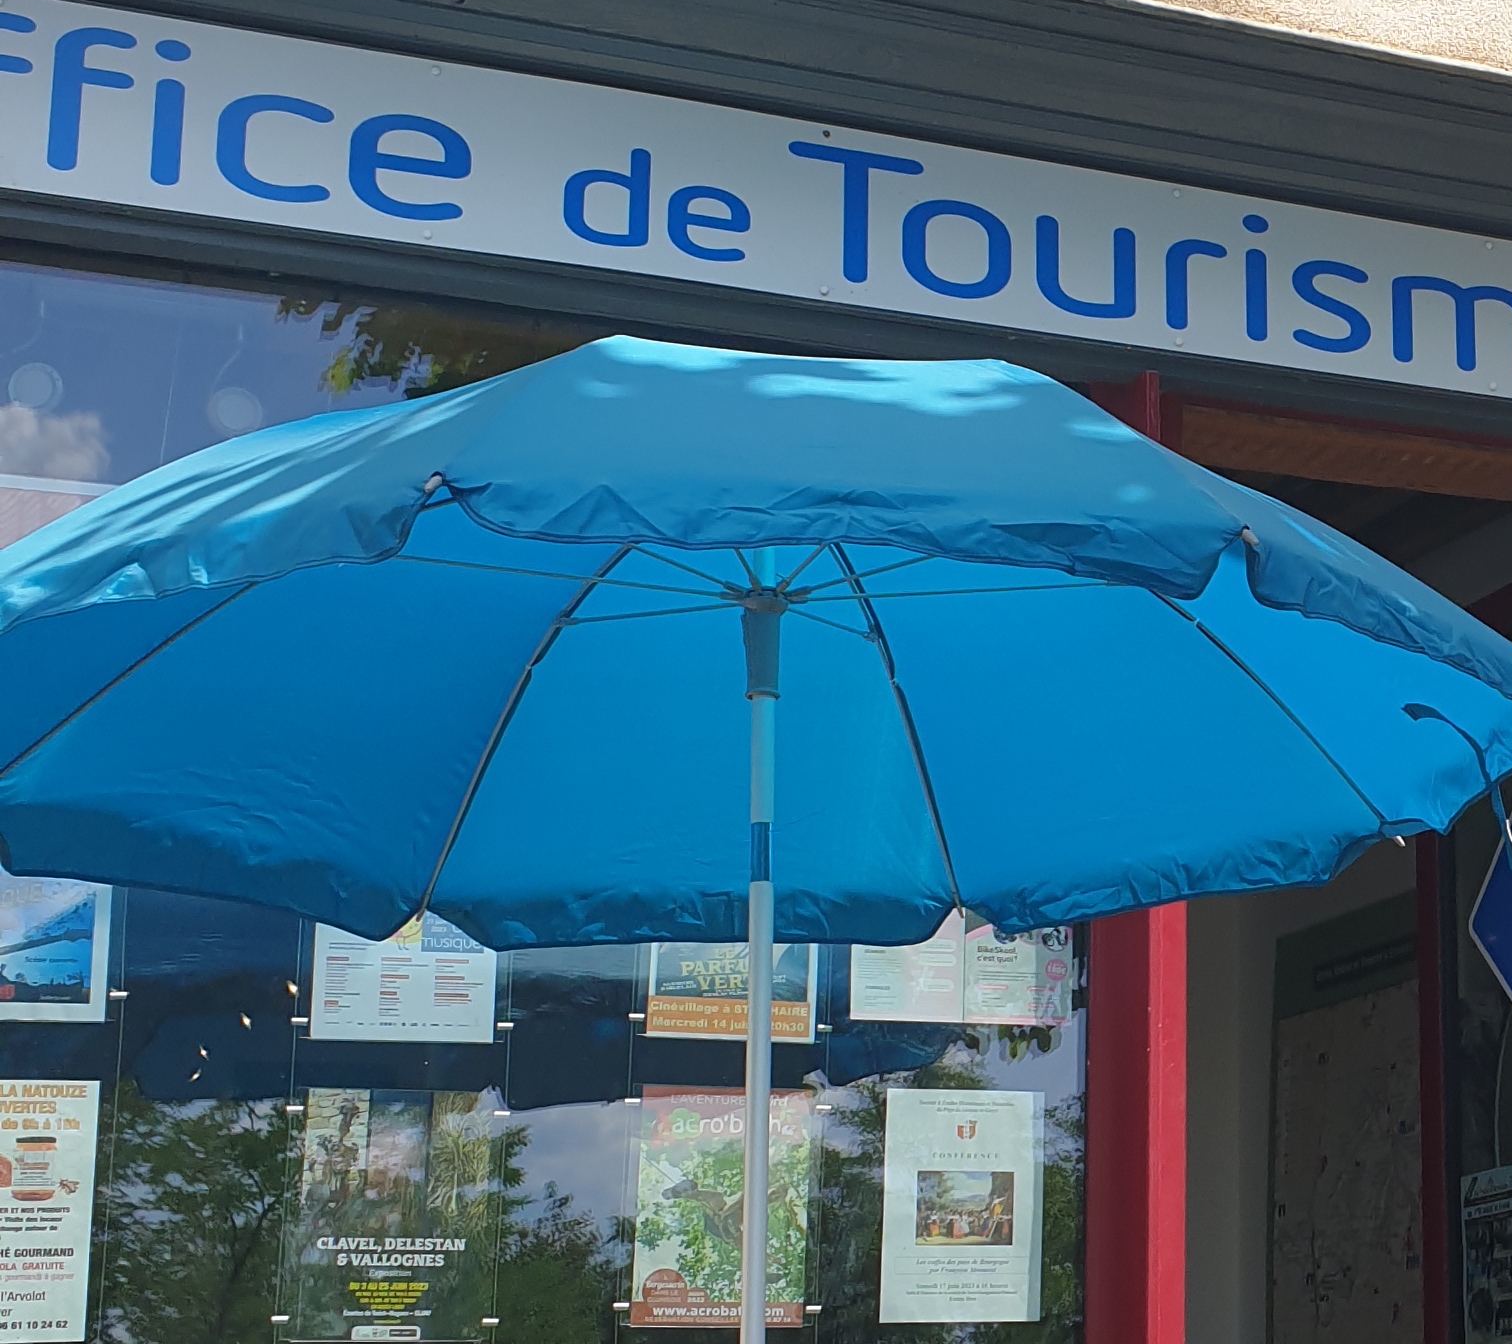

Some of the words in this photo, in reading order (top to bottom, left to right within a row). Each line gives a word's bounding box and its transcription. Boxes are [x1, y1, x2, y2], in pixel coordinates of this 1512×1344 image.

[562, 147, 752, 263] de
[681, 959, 749, 976] PARFU
[650, 1001, 719, 1014] Cinévillage
[652, 1016, 707, 1028] Mercredi
[712, 1018, 726, 1027] 14
[730, 1019, 749, 1031] jui
[316, 1237, 383, 1253] CLAVEL,
[384, 1237, 467, 1251] DELESTAN
[13, 1247, 74, 1258] GOURMAND
[22, 1261, 65, 1271] GRATUITE
[351, 1253, 446, 1267] VALLOGNES
[11, 1321, 22, 1330] 61
[27, 1321, 38, 1329] 10
[41, 1320, 53, 1329] 24
[55, 1320, 69, 1329] 62
